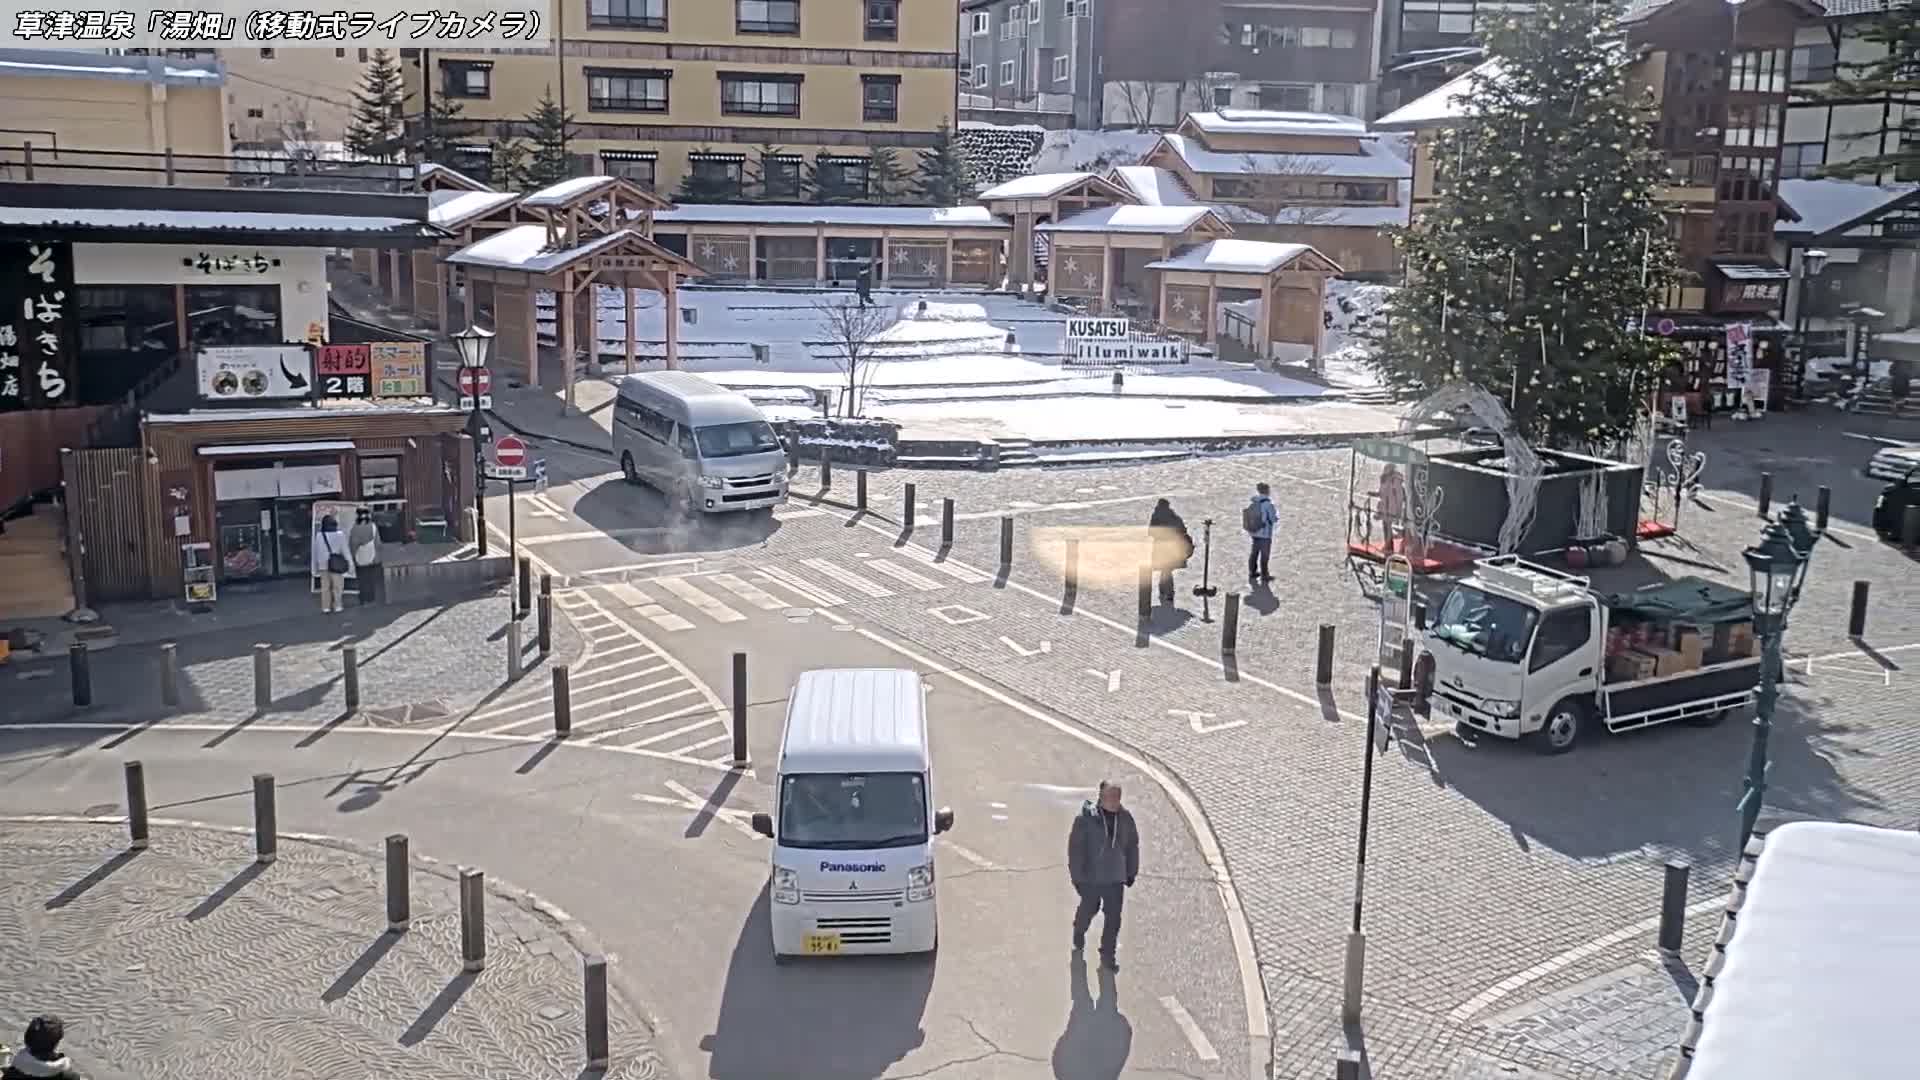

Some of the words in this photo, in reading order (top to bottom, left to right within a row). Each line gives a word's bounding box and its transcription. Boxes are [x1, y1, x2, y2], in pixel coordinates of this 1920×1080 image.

[196, 251, 269, 274] そばきち
[24, 245, 66, 398] そばきち
[1069, 319, 1127, 337] KUSATSU
[322, 347, 367, 371] 射的
[326, 376, 364, 394] 2階
[820, 861, 887, 873] Panasonic
